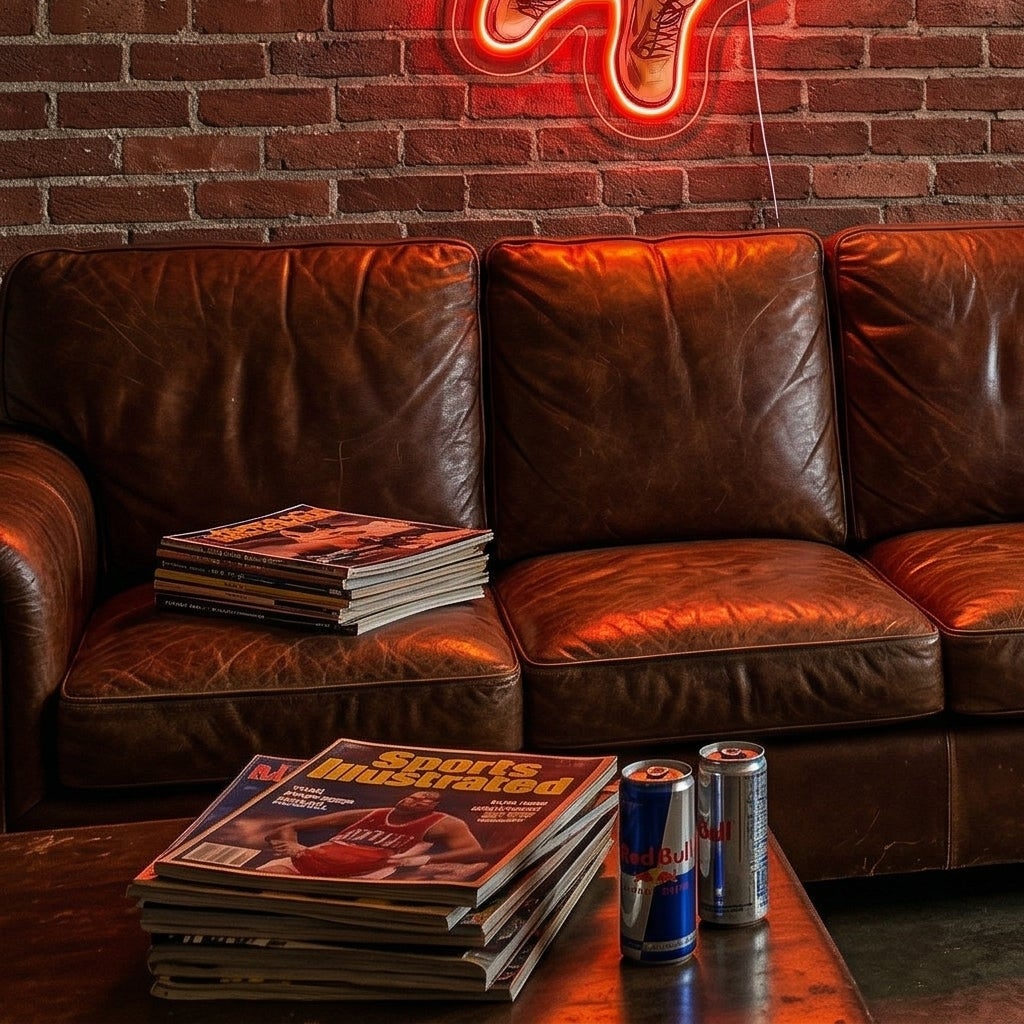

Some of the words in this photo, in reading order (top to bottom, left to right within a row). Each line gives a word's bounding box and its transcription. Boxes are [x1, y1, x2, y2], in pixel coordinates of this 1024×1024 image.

[307, 757, 575, 796] Illustrated
[371, 750, 543, 778] Sports
[658, 837, 695, 866] Bull
